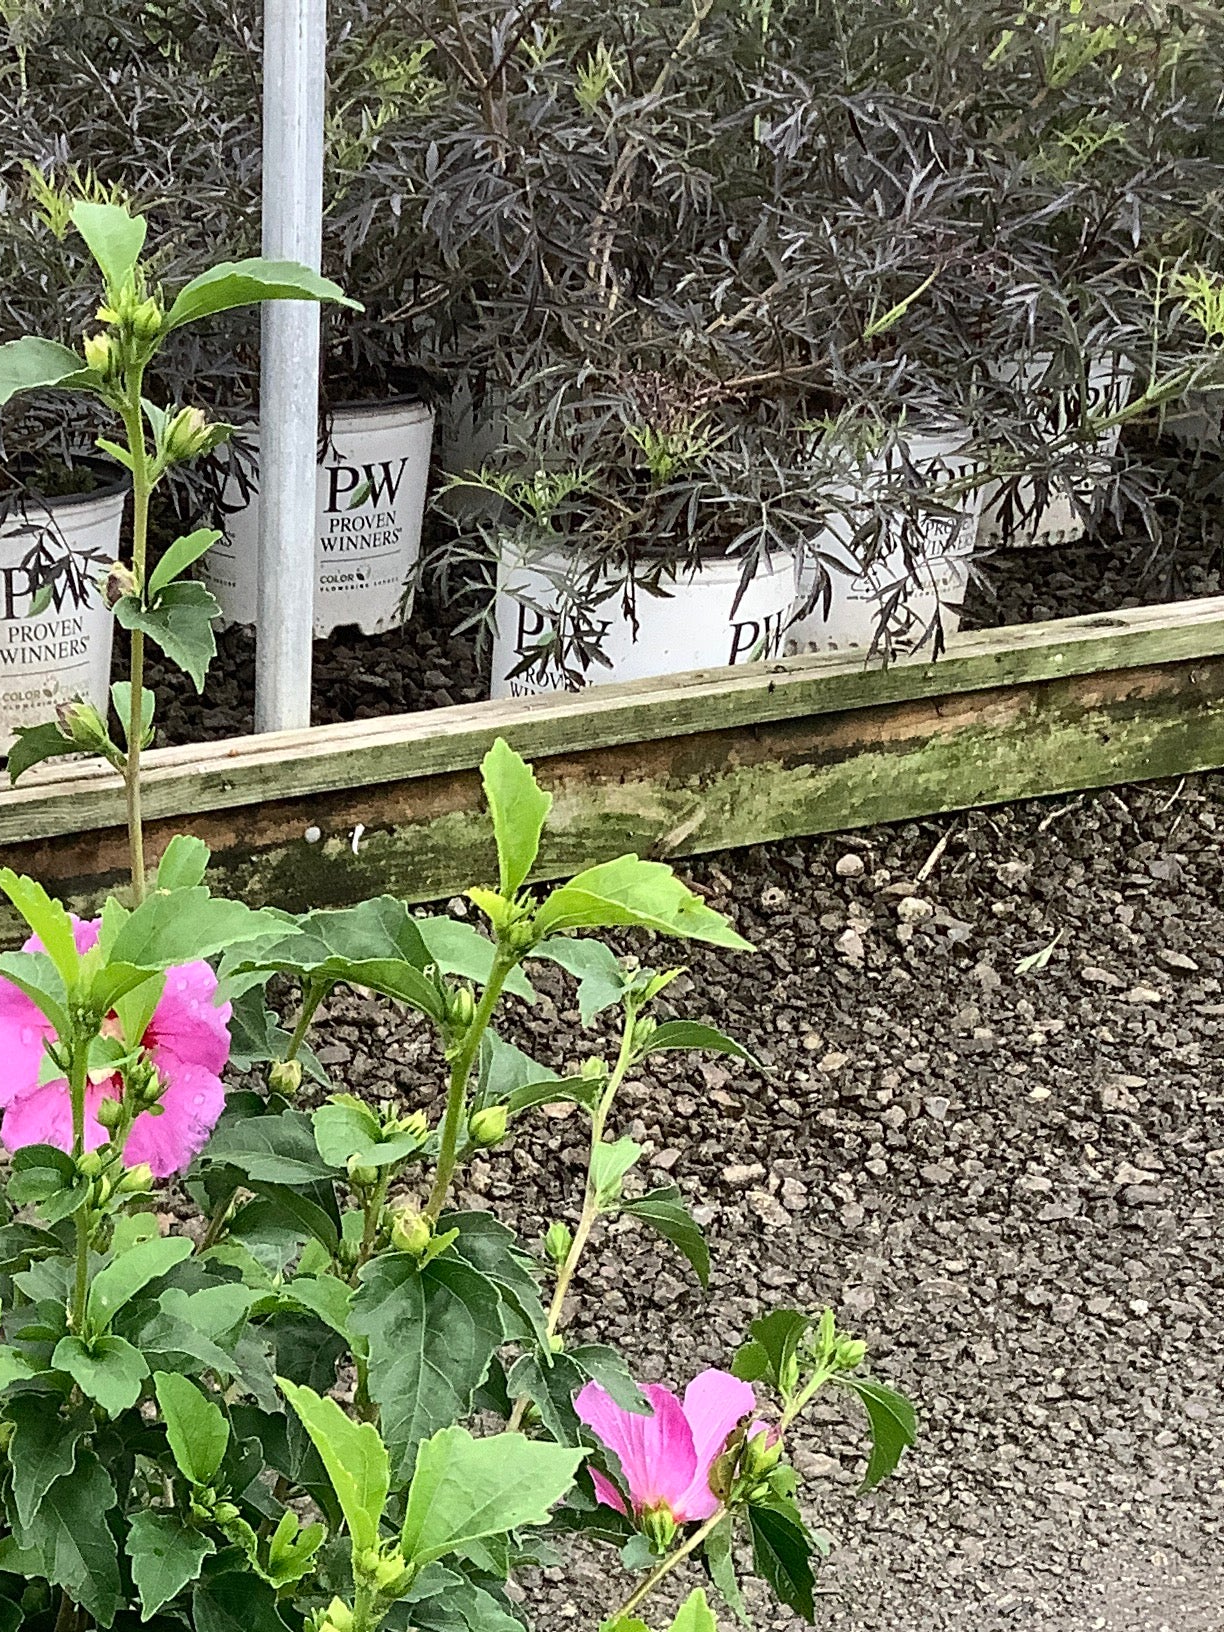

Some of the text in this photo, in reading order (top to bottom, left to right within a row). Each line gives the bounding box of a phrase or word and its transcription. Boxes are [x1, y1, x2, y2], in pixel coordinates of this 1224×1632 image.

[323, 457, 409, 513] PW
[329, 510, 397, 533] PROVEN
[320, 573, 354, 584] COLOR
[8, 616, 84, 643] PROVEN
[2, 690, 41, 702] COLOR
